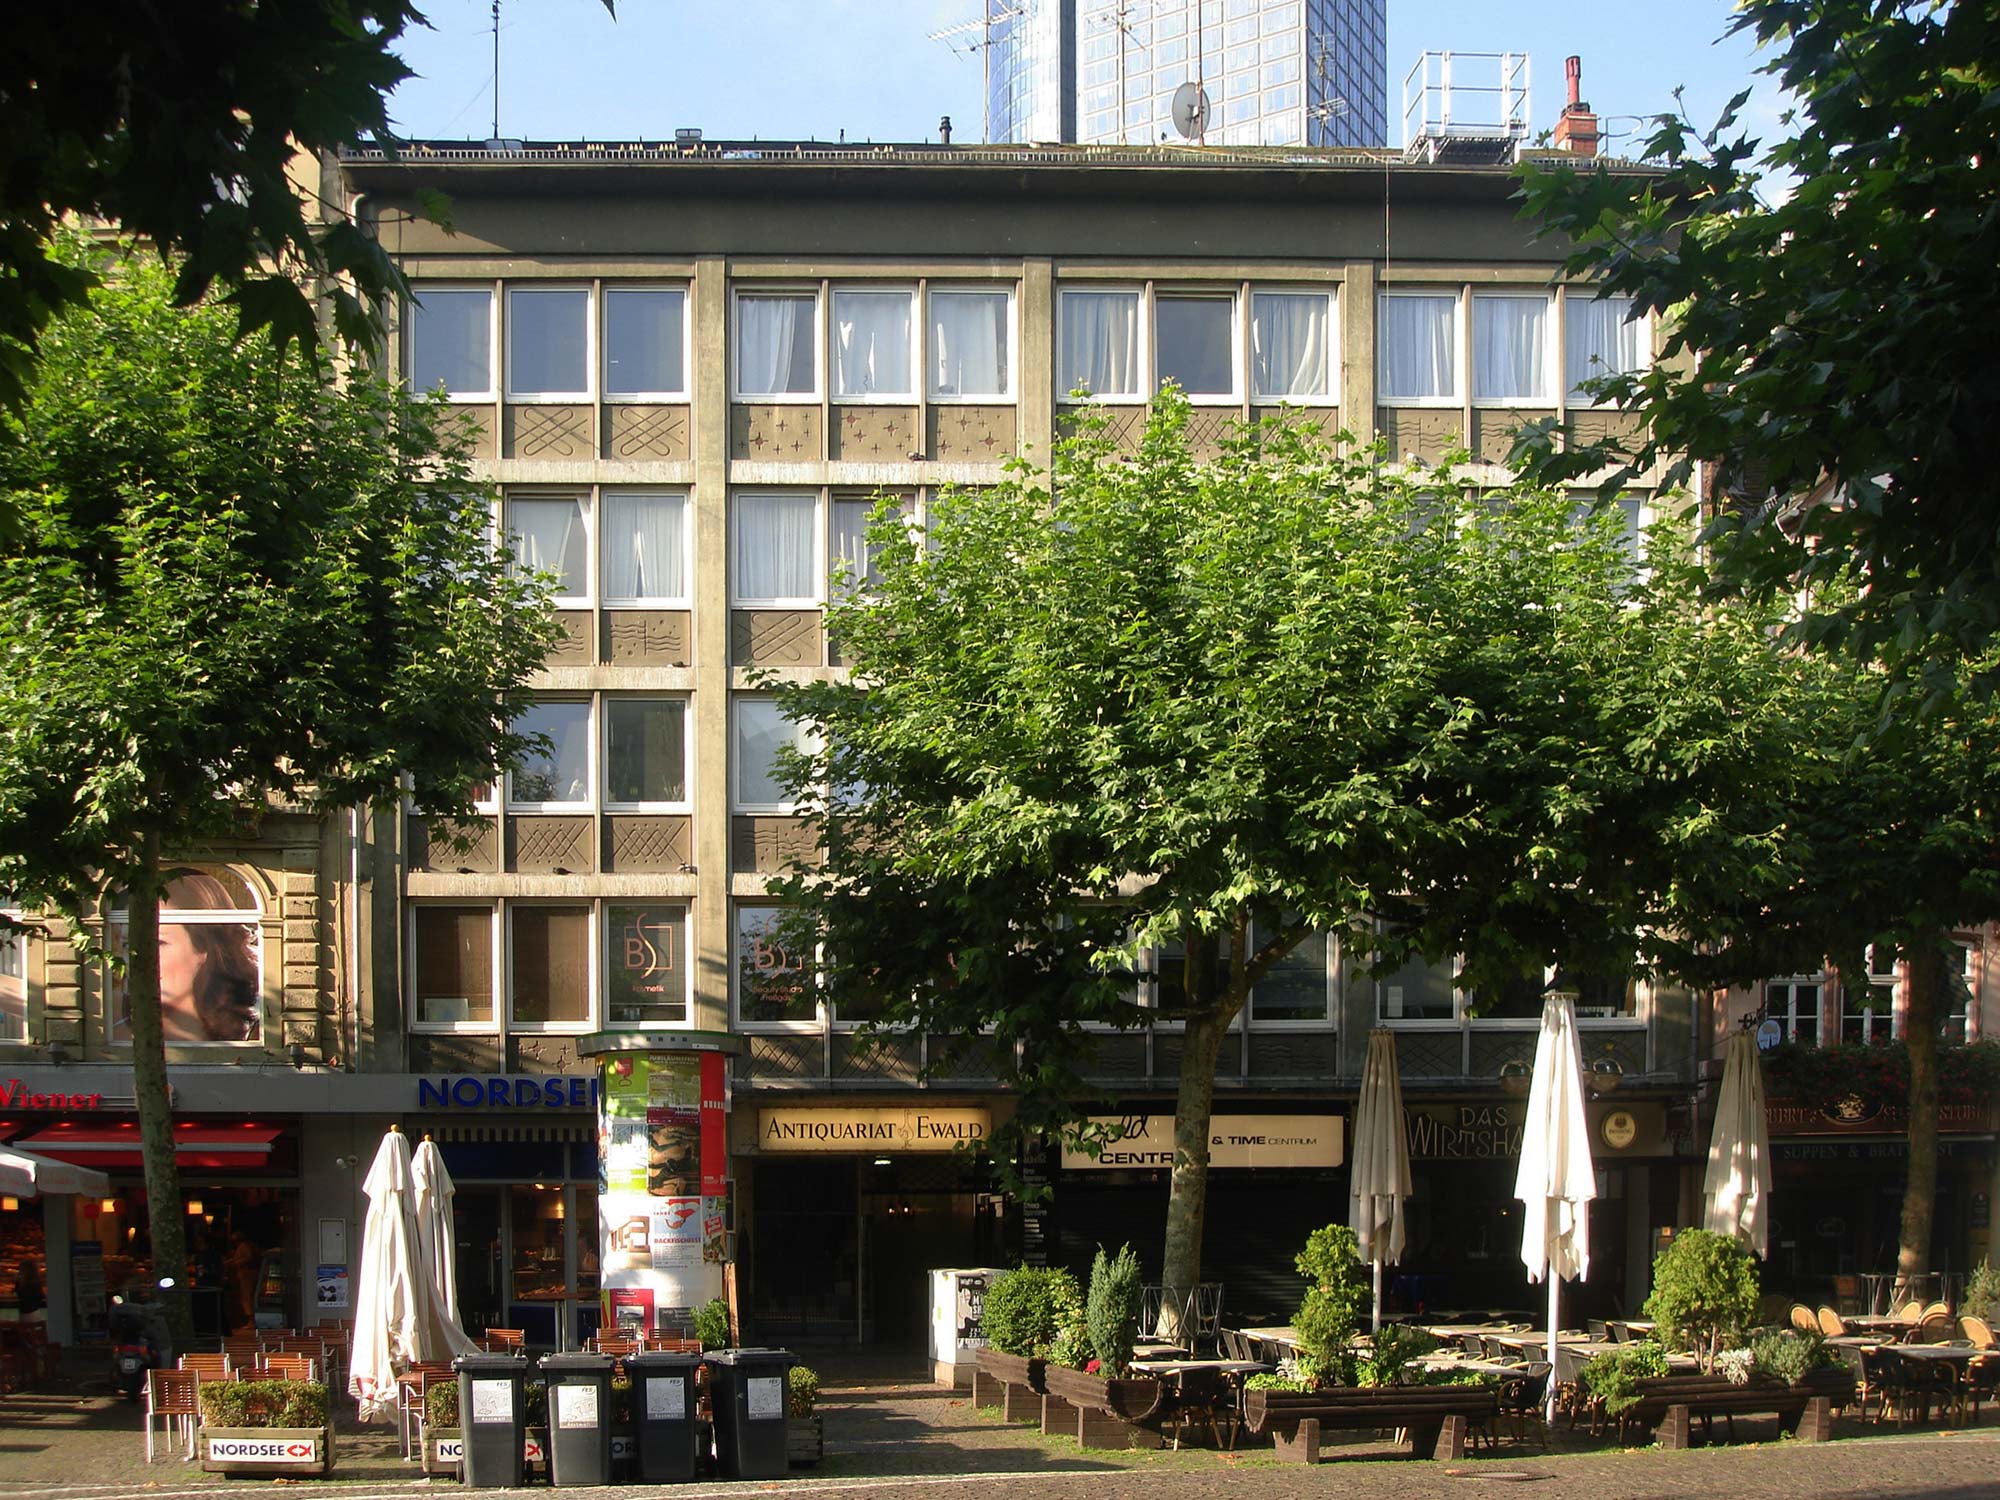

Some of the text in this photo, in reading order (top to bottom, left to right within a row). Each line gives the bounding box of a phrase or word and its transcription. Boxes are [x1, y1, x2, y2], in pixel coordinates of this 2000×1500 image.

[1460, 1106, 1508, 1127] DAS
[1228, 1136, 1266, 1145] TIME
[213, 1444, 285, 1456] NORDSEE
